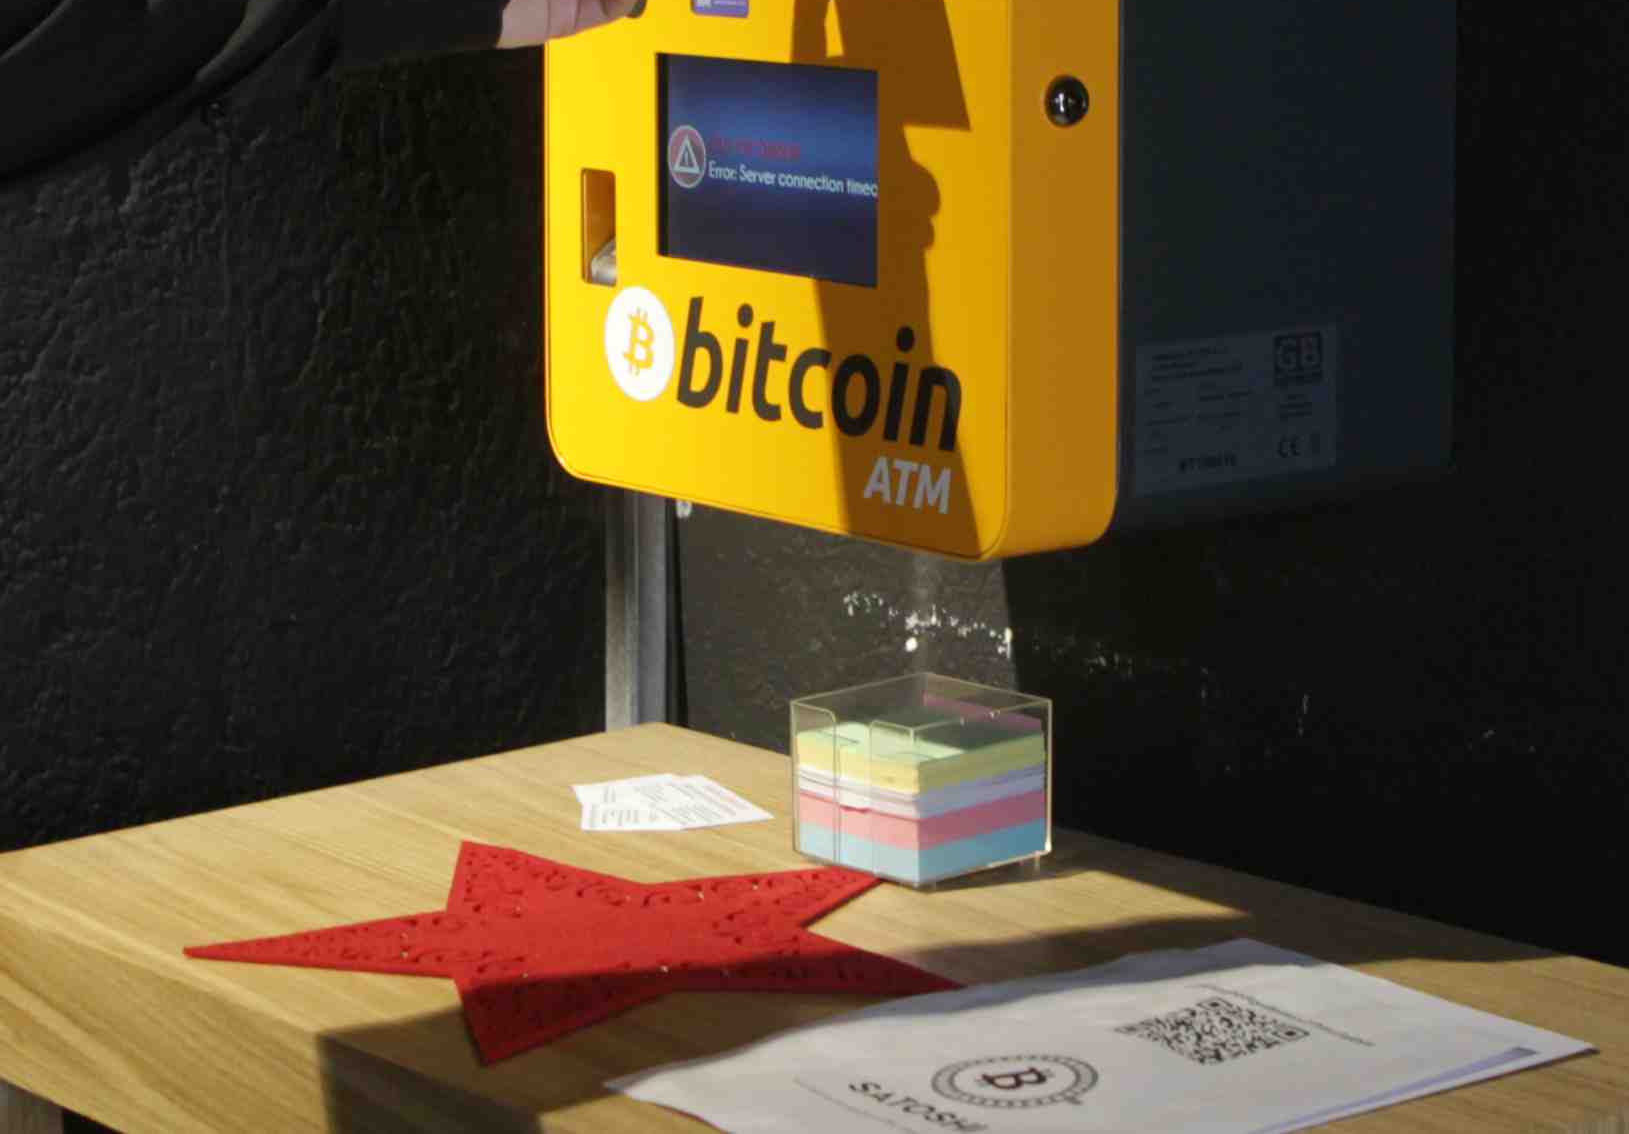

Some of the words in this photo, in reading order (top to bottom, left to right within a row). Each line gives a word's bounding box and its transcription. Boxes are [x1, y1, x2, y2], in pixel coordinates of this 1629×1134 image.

[739, 164, 776, 186] Server
[778, 171, 844, 194] connection
[676, 296, 962, 452] bitcoin
[863, 456, 951, 515] ATM
